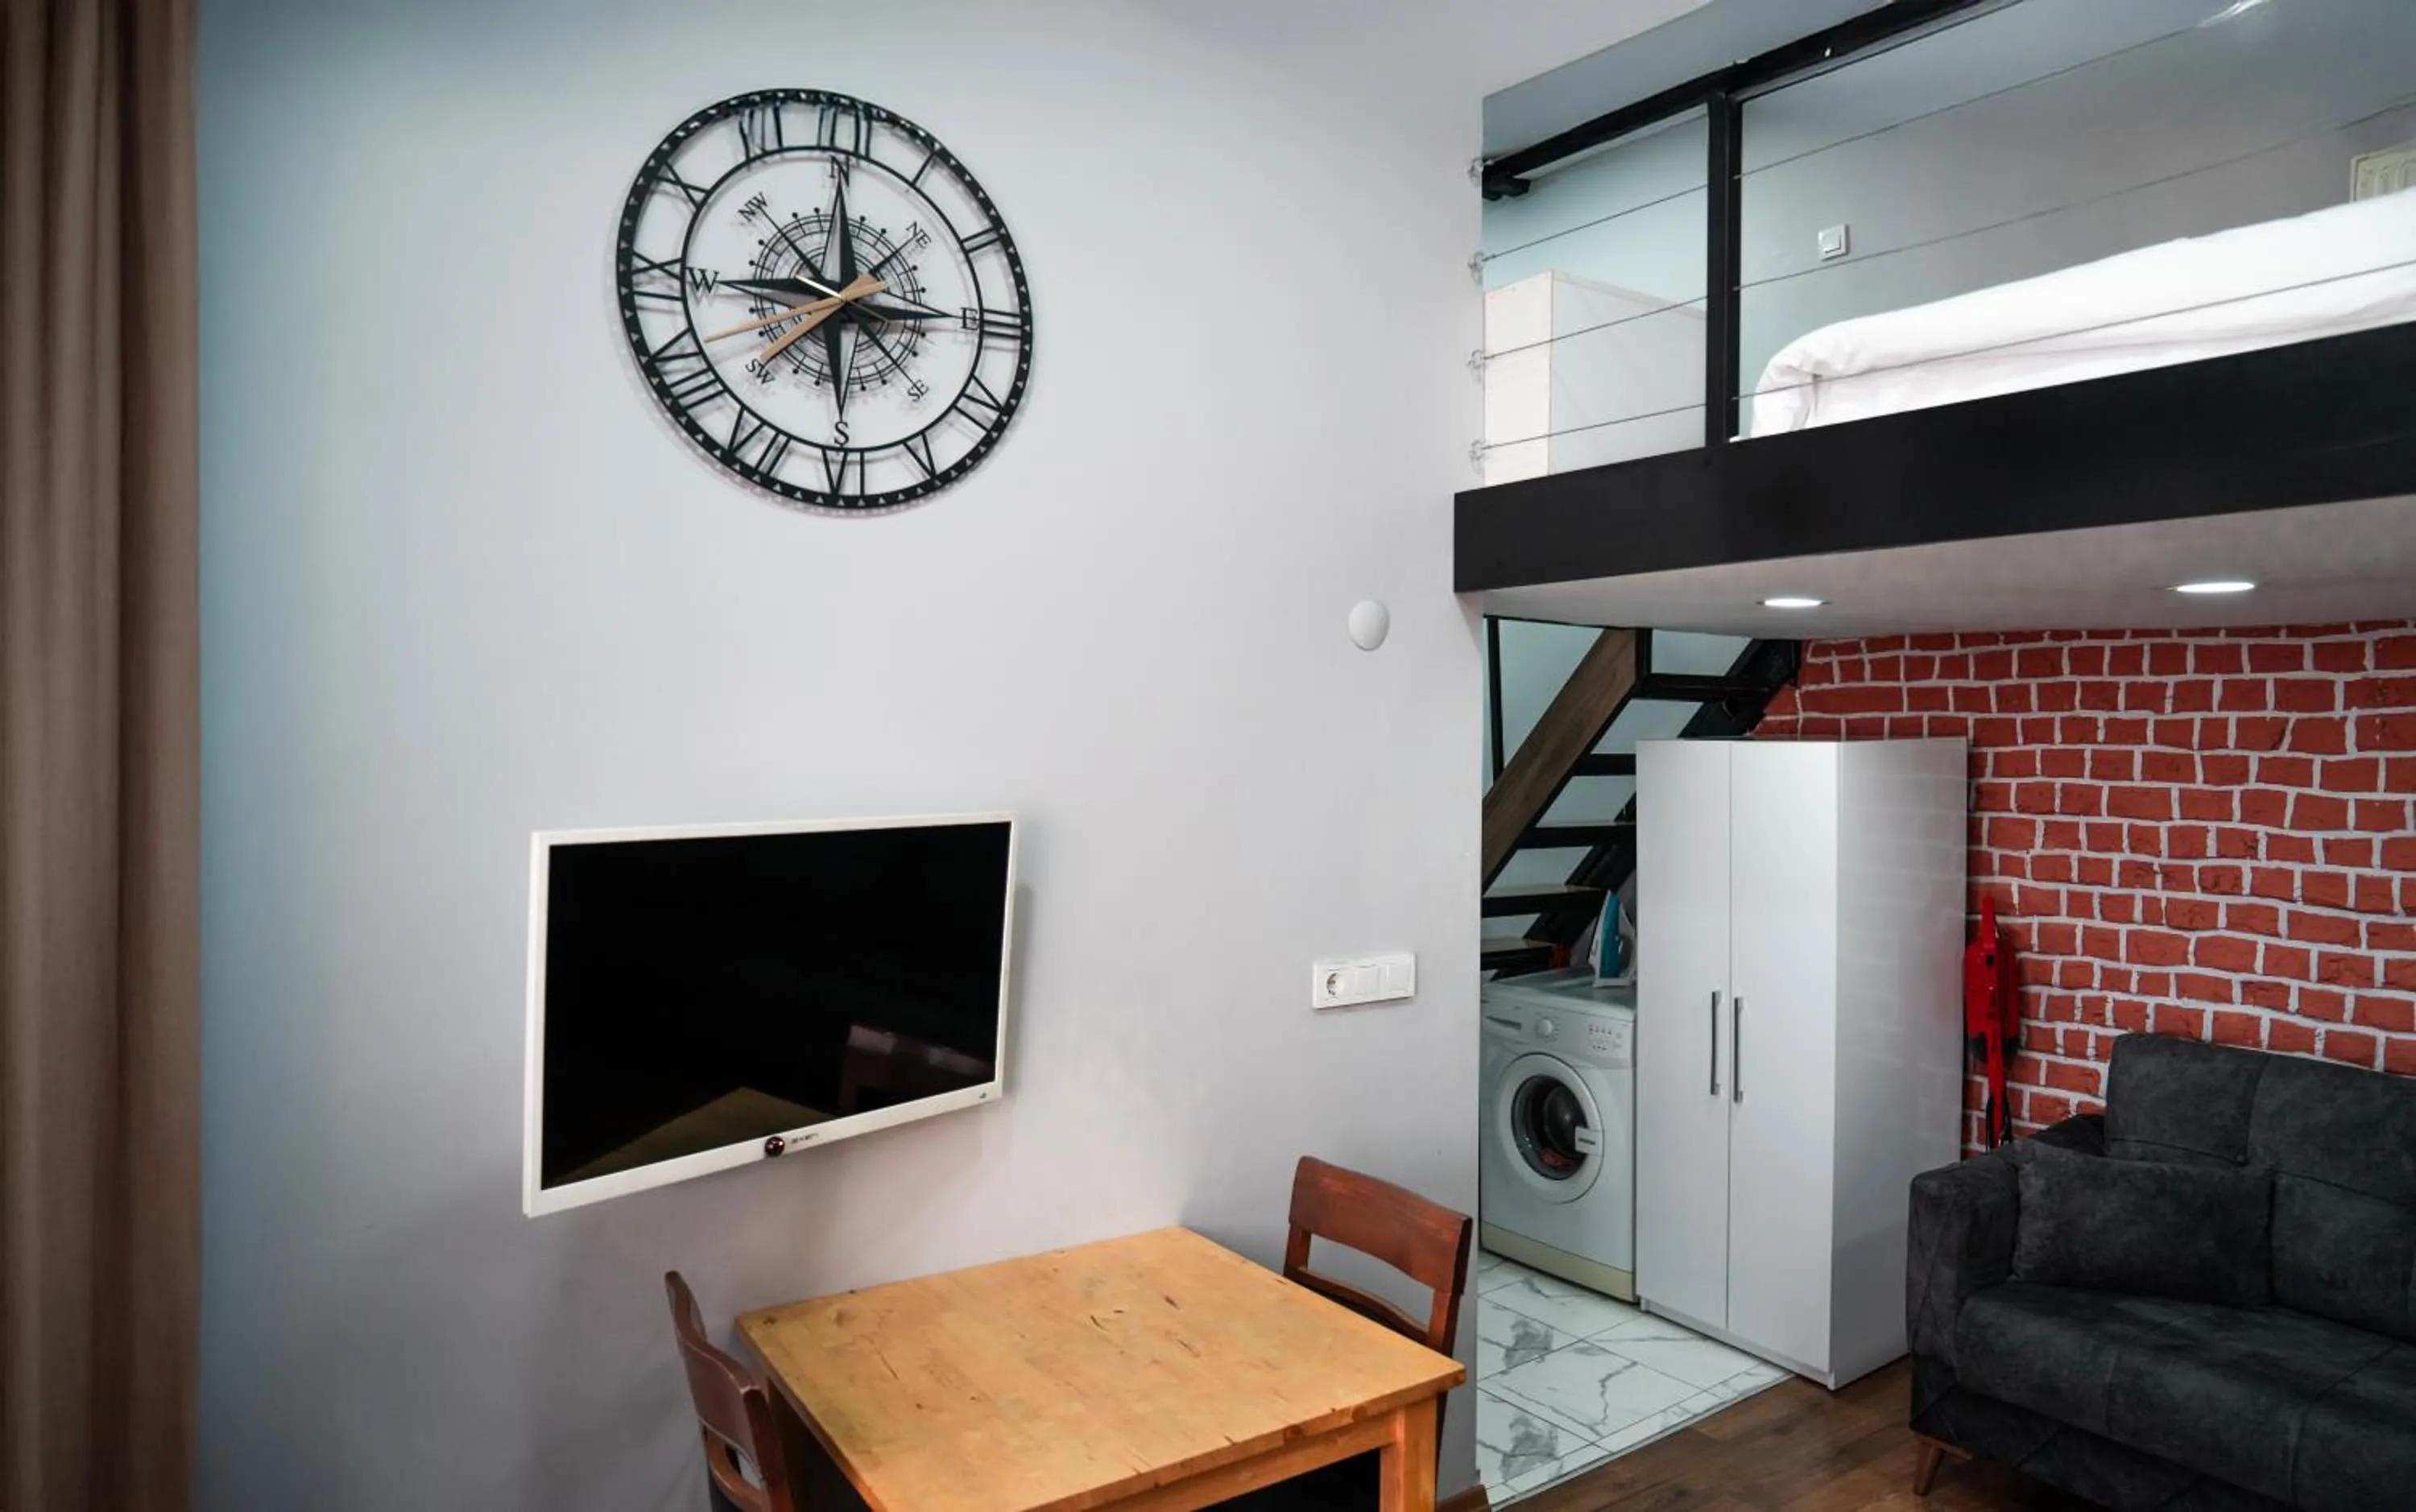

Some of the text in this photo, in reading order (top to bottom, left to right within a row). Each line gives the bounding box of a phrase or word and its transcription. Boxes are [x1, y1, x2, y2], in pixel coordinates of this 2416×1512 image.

[652, 161, 712, 211] X
[829, 155, 849, 188] N
[738, 191, 768, 223] NW
[905, 220, 933, 250] NE
[958, 225, 1001, 255] II
[685, 266, 720, 294] W
[961, 307, 979, 331] E
[980, 308, 1023, 339] III
[649, 325, 728, 412] VIII
[744, 357, 776, 385] SW
[906, 379, 930, 403] SE
[954, 374, 1003, 432] IV
[726, 403, 792, 475] VII
[834, 421, 850, 444] S
[821, 446, 865, 497] VI
[903, 432, 938, 481] V
